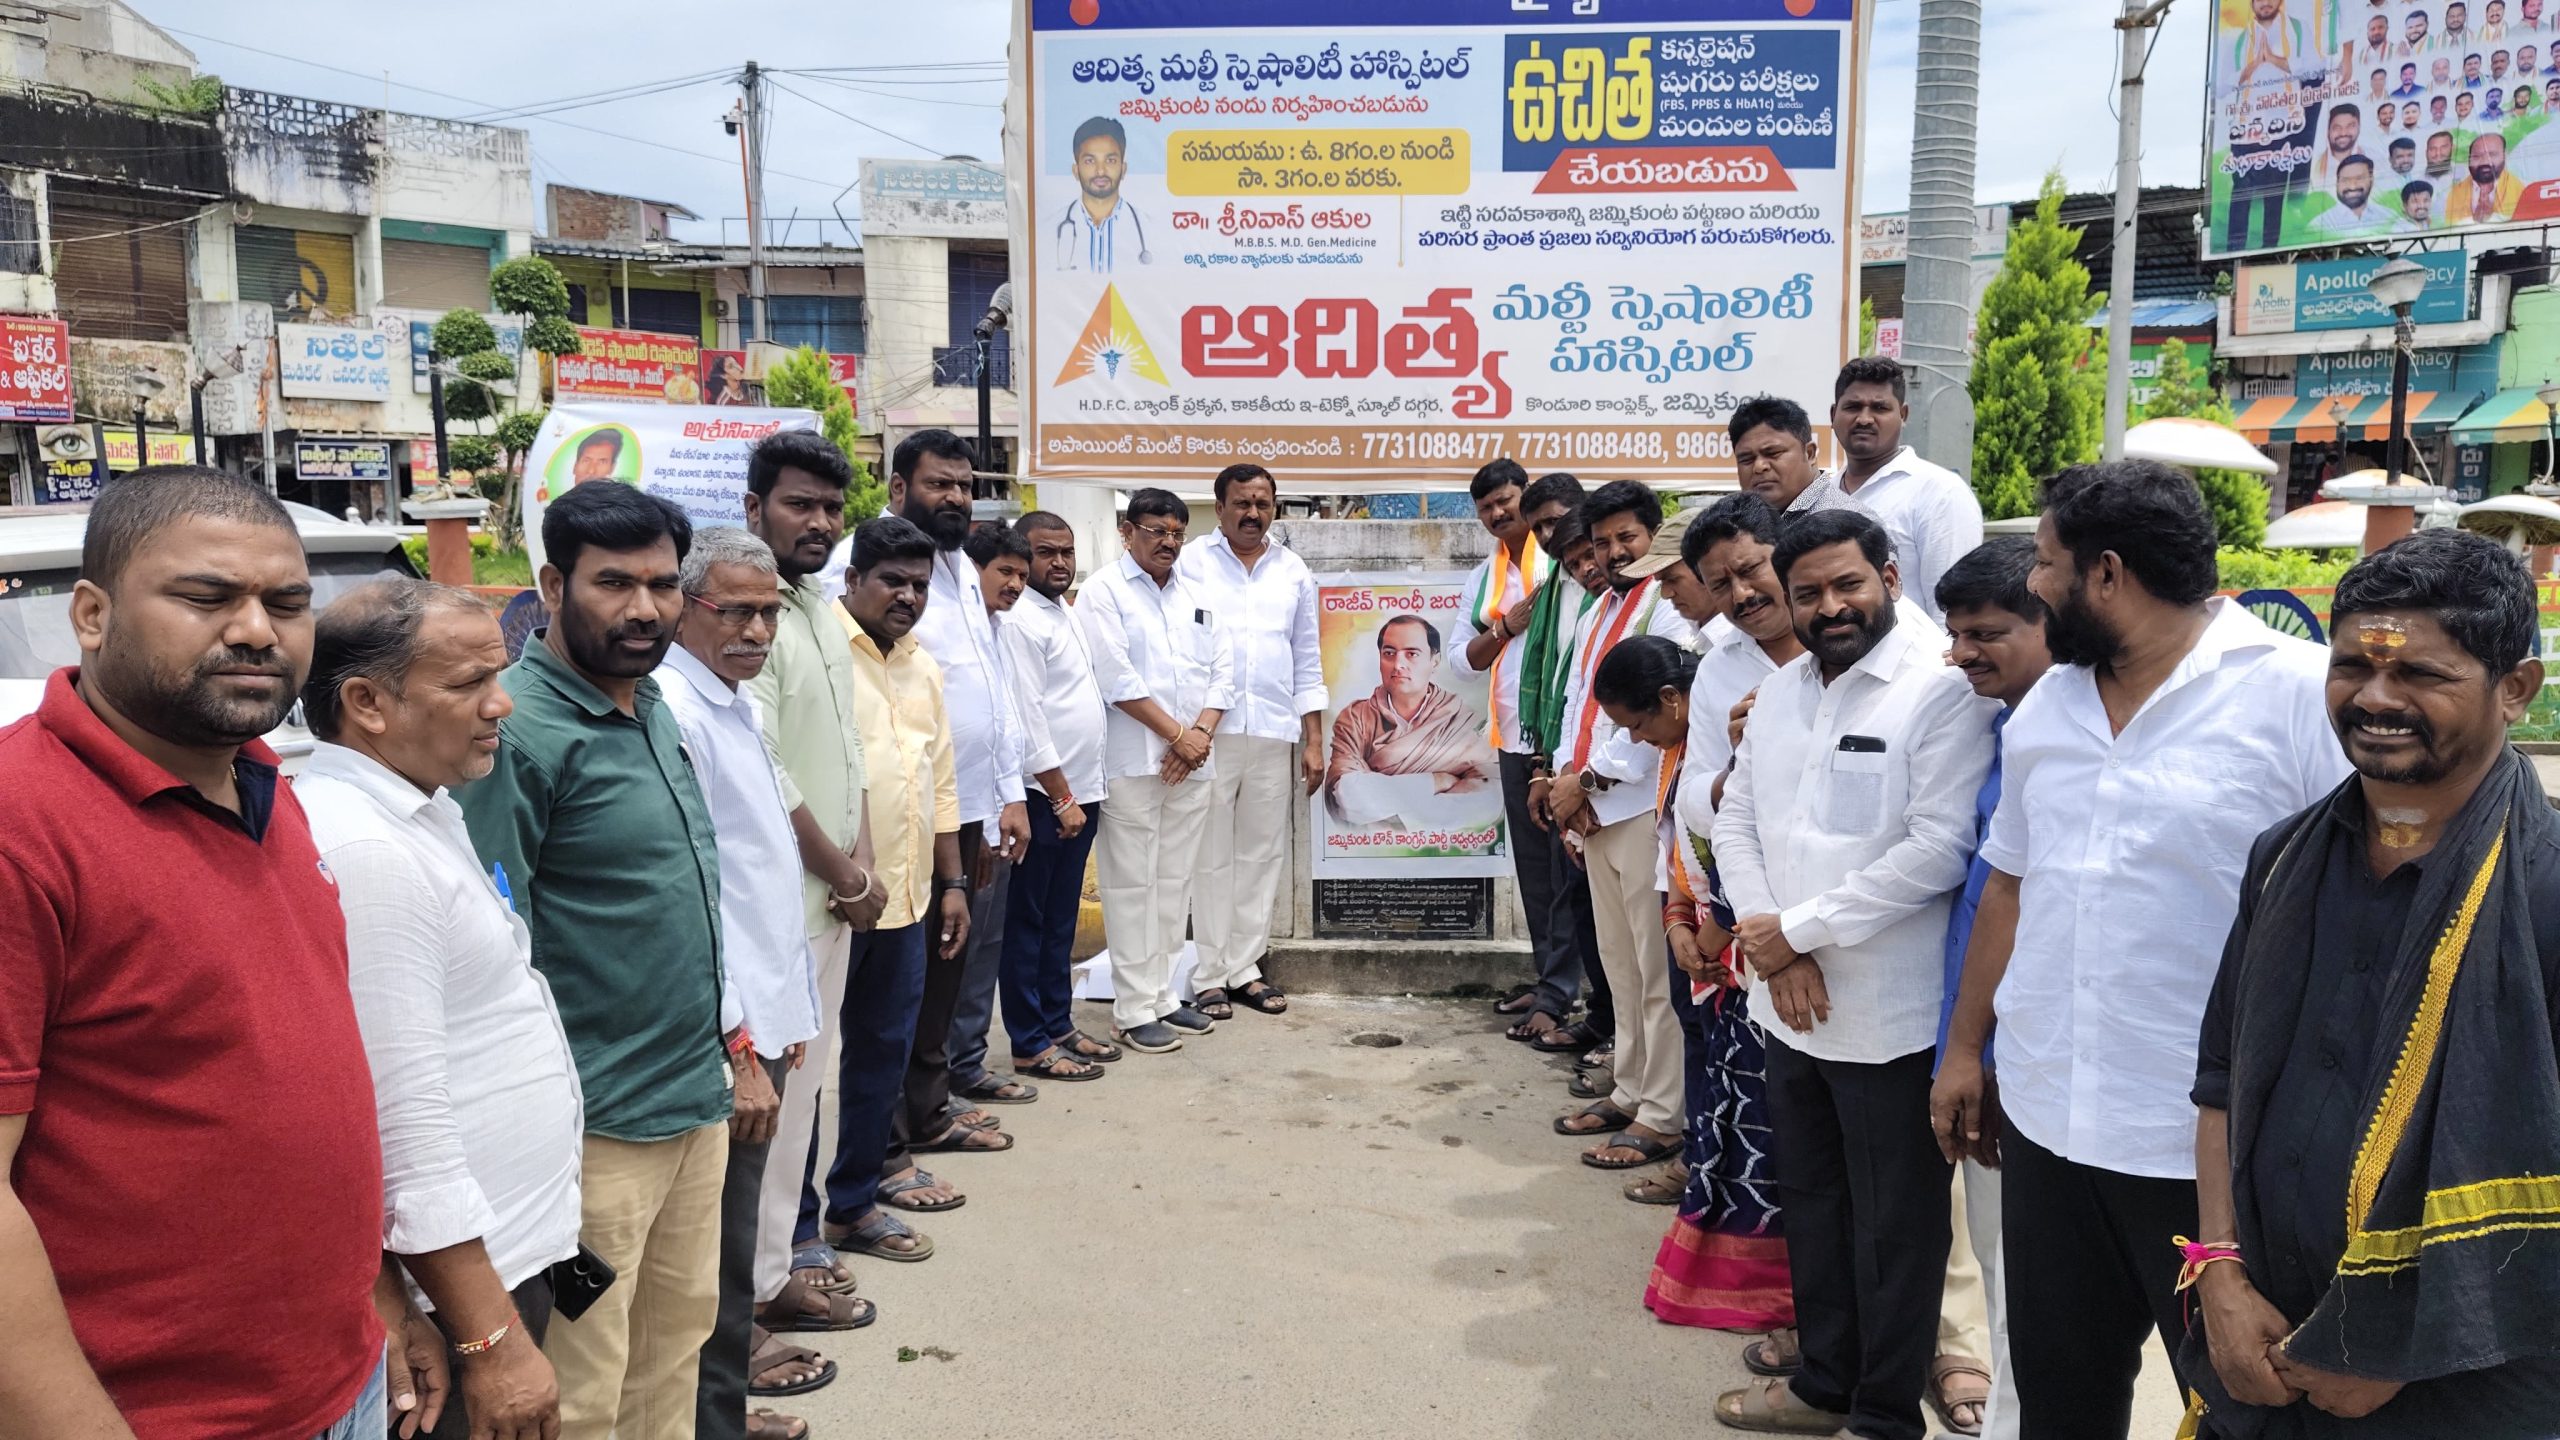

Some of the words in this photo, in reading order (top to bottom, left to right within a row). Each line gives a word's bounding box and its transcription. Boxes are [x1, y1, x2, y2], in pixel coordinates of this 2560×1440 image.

[1072, 54, 1155, 95] ఆదిత్య
[1160, 48, 1219, 91] మల్టీ
[1226, 42, 1343, 91] స్పెషాలిటీ
[1349, 47, 1473, 92] హాస్పిటల్
[1660, 73, 1735, 95] షుగరు
[1740, 66, 1820, 102] పరీక్షలు
[1119, 96, 1210, 122] జమ్మికుంట
[1215, 97, 1266, 116] నందు
[1272, 95, 1429, 121] నిర్వహించబడును
[1660, 99, 1687, 112] (FBS,
[1691, 99, 1720, 110] PPBS
[1724, 99, 1733, 110] &
[1736, 98, 1774, 111] HbA1c)
[1659, 117, 1752, 137] మందుల
[1757, 108, 1833, 137] పంపిణీ
[1182, 144, 1284, 163] సమయము
[1401, 136, 1455, 162] నుండి
[1568, 154, 1769, 185] చేయబడును
[1216, 202, 1303, 236] శ్రీనివాస్
[1311, 208, 1371, 229] ఆకుల
[1440, 204, 1471, 229] ఇట్టి
[1476, 204, 1586, 227] సదవకాశాన్ని
[1589, 203, 1677, 227] జమ్మికుంట
[1682, 204, 1745, 229] పట్టణం
[1749, 203, 1819, 221] మరియు
[1234, 237, 1277, 248] M.B.B.S.
[1281, 237, 1303, 248] M.D.
[1306, 236, 1376, 248] Gen.Medicine
[1419, 229, 1479, 248] పరిసర
[1483, 229, 1536, 250] ప్రాంత
[1540, 229, 1591, 250] ప్రజలు
[1596, 228, 1697, 250] సద్వినియోగ
[1701, 226, 1835, 247] పరుచుకోగలరు.
[1183, 253, 1207, 268] అన్ని
[1208, 253, 1239, 266] రకాల
[1241, 253, 1294, 269] వ్యాధులకు
[1296, 252, 1363, 265] చూడబడును
[2254, 297, 2291, 313] Apollo
[306, 333, 385, 362] నిఖిల్
[1181, 288, 1512, 419] ఆదిత్య
[1492, 281, 1592, 334] మల్టీ
[1607, 272, 1814, 331] స్పెషాలిటీ
[1549, 331, 1757, 384] హాస్పిటల్
[1134, 396, 1180, 417] బ్యాంక్
[1231, 397, 1296, 413] కాకతీయ
[1357, 396, 1402, 418] స్కూల్
[1525, 396, 1591, 413] కొండూరి
[1048, 434, 1132, 456] అపాయింట్
[1135, 434, 1182, 456] మెంట్
[1186, 434, 1234, 456] కొరకు
[1237, 434, 1343, 458] సంప్రదించండి
[1362, 432, 1509, 461] 7731088477,
[1518, 431, 1668, 463] 7731088488,
[1325, 590, 1374, 611] రాజీవ్
[1379, 588, 1425, 612] గాంధీ
[1328, 831, 1370, 850] జమ్మికుంట
[1373, 830, 1393, 846] టౌన్
[1395, 830, 1425, 849] కాంగ్రెస్
[1429, 829, 1449, 851] పార్టీ
